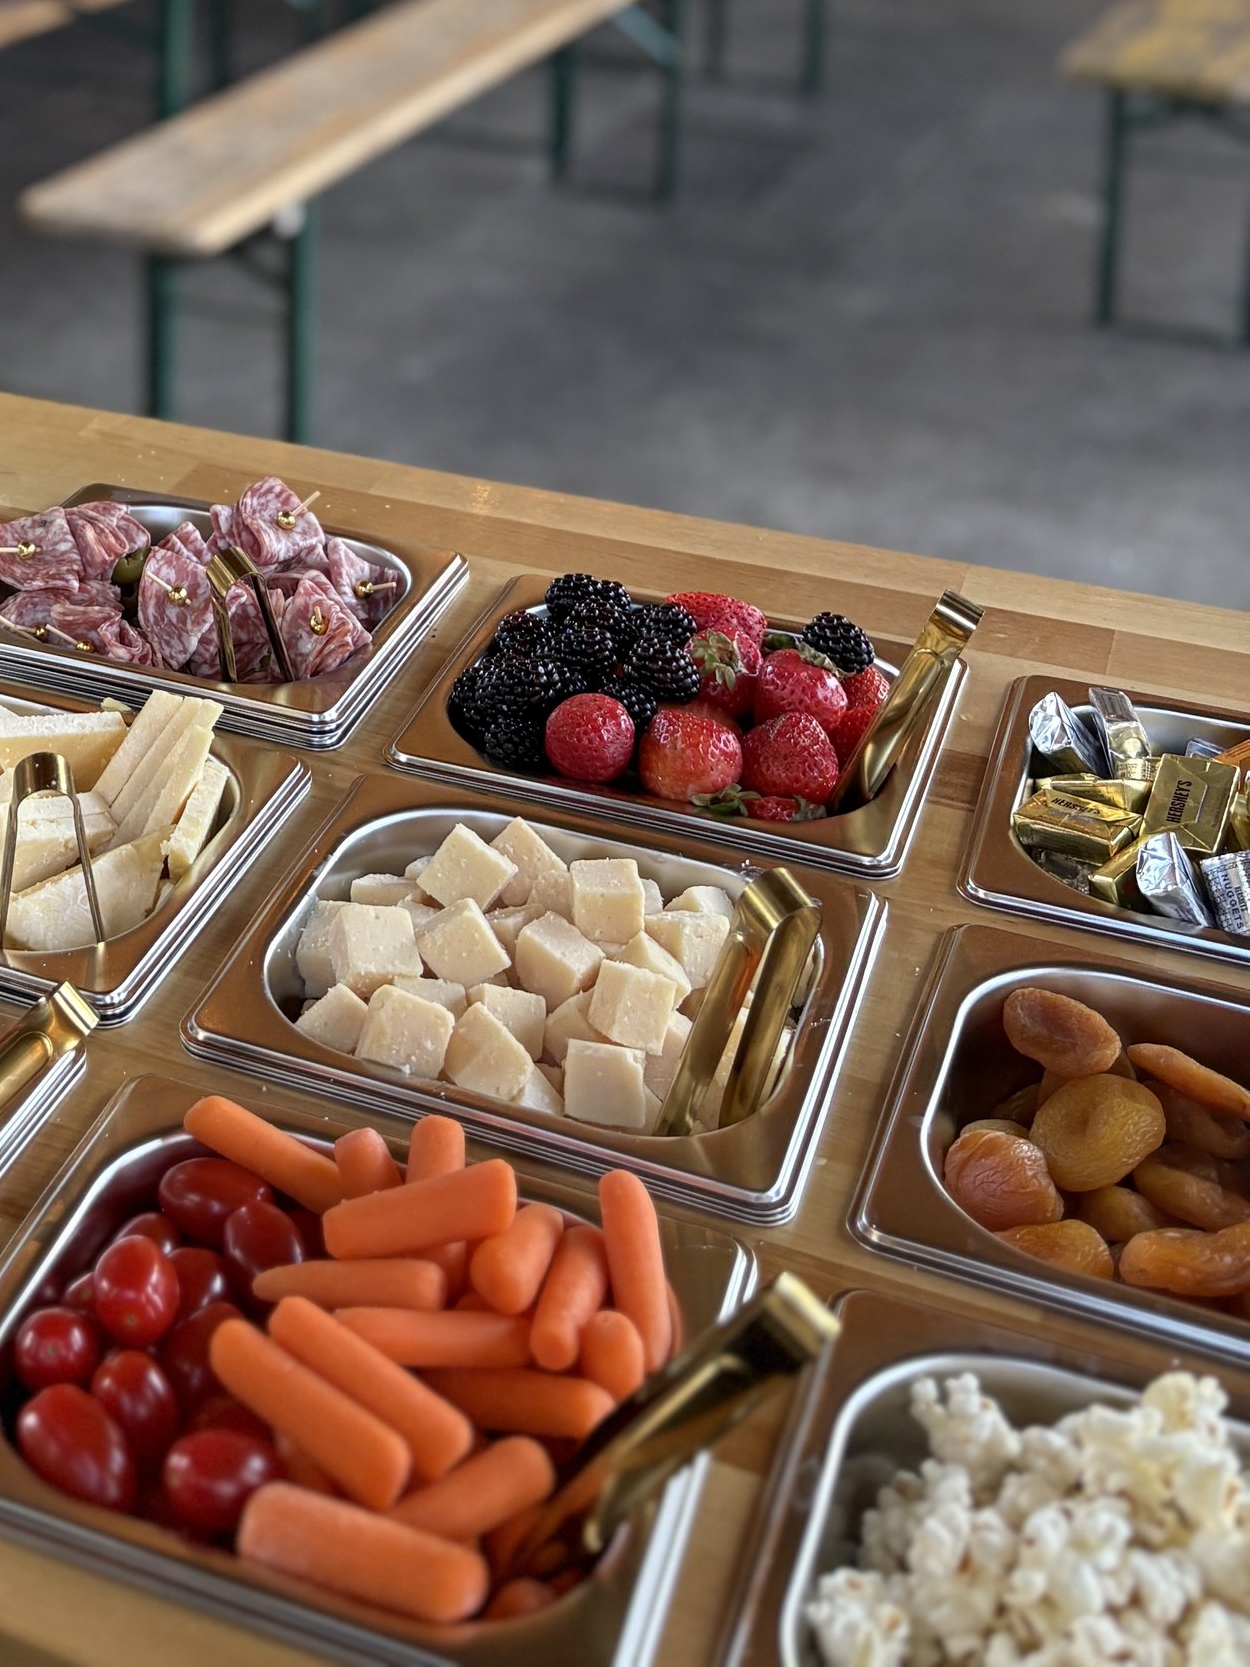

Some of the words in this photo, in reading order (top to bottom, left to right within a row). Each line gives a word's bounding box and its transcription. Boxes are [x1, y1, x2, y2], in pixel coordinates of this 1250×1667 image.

[1050, 797, 1102, 815] HERSHEY'S
[1165, 779, 1193, 824] HERSHEY'S
[1221, 871, 1245, 931] NUGGETS
